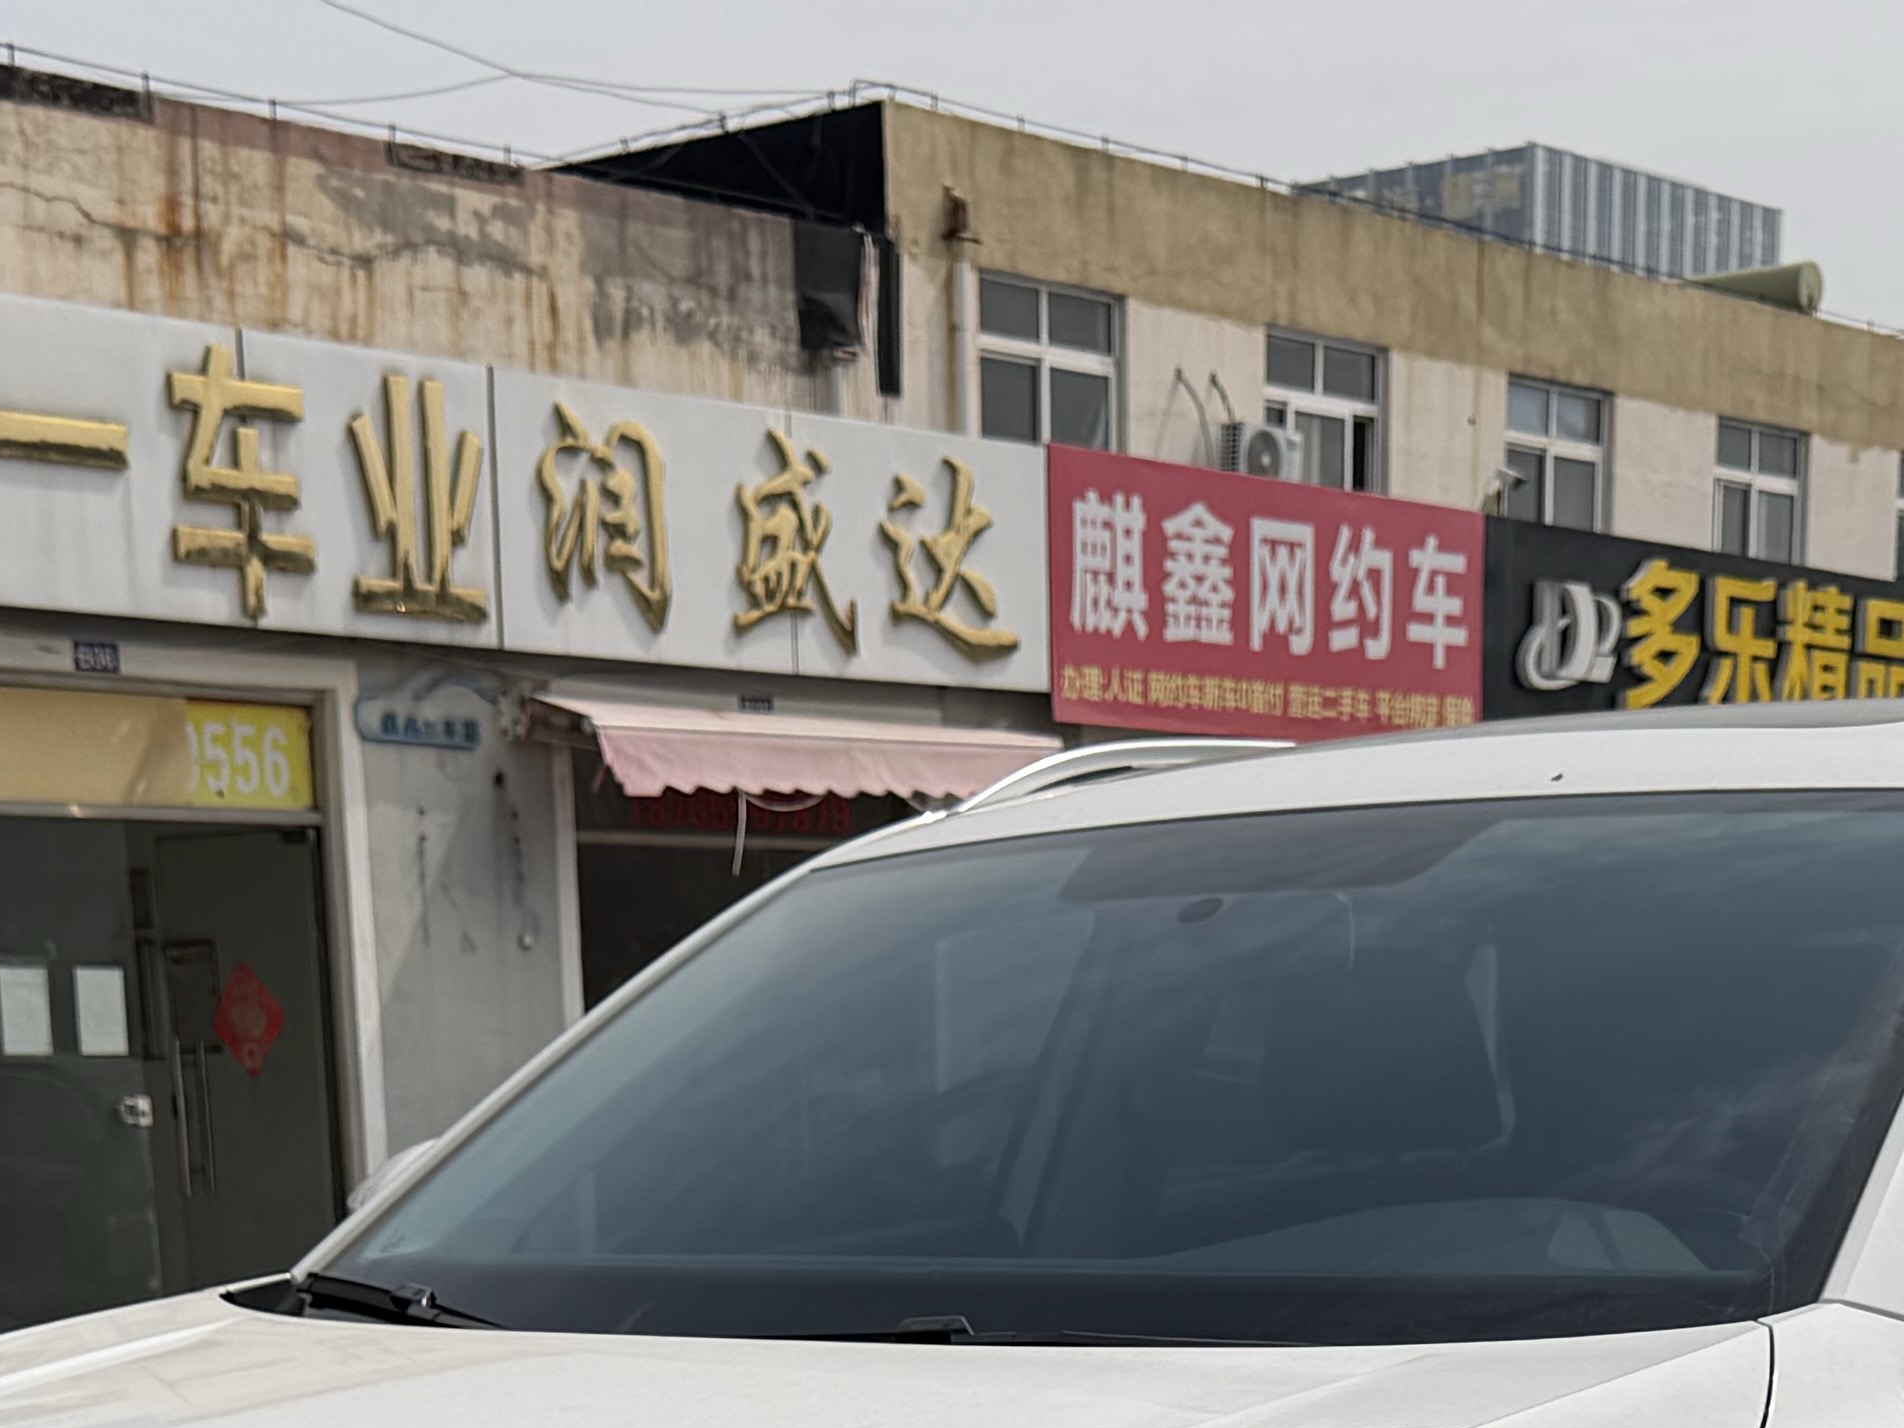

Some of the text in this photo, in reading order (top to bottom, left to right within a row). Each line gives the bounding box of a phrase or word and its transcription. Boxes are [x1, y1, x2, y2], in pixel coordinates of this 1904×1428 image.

[1069, 487, 1469, 669] 麒鑫网约车
